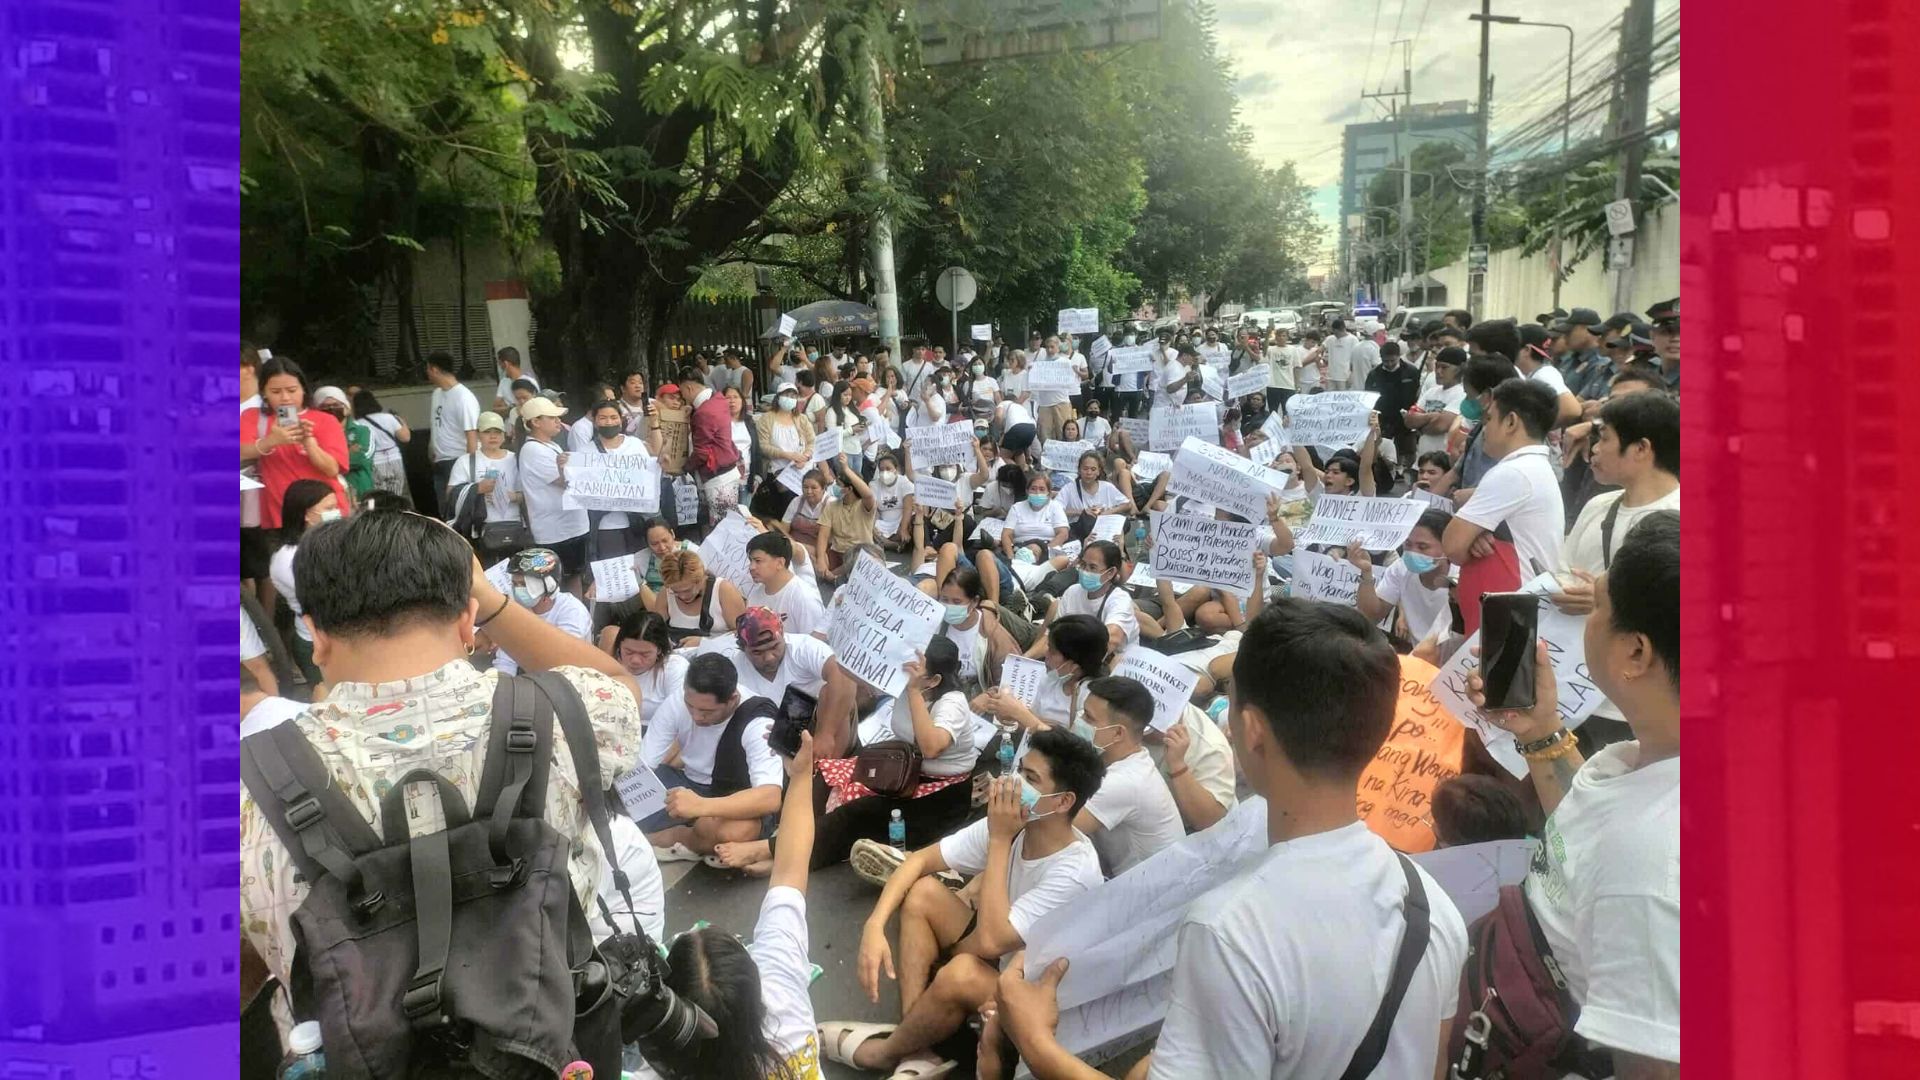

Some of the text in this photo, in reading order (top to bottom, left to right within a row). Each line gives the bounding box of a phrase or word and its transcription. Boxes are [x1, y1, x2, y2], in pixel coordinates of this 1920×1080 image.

[583, 453, 648, 470] IPAGLABAN
[1198, 444, 1240, 467] GUSTO
[1247, 464, 1266, 479] NA
[602, 468, 631, 483] ANG
[573, 480, 645, 497] KABUHAYAN
[1316, 500, 1359, 522] WOWEE
[1361, 501, 1414, 523] MARKET
[1196, 521, 1217, 537] ang
[1311, 558, 1334, 584] Wag
[881, 578, 935, 622] Market:
[1147, 660, 1188, 694] MARKET
[1377, 744, 1411, 774] ang
